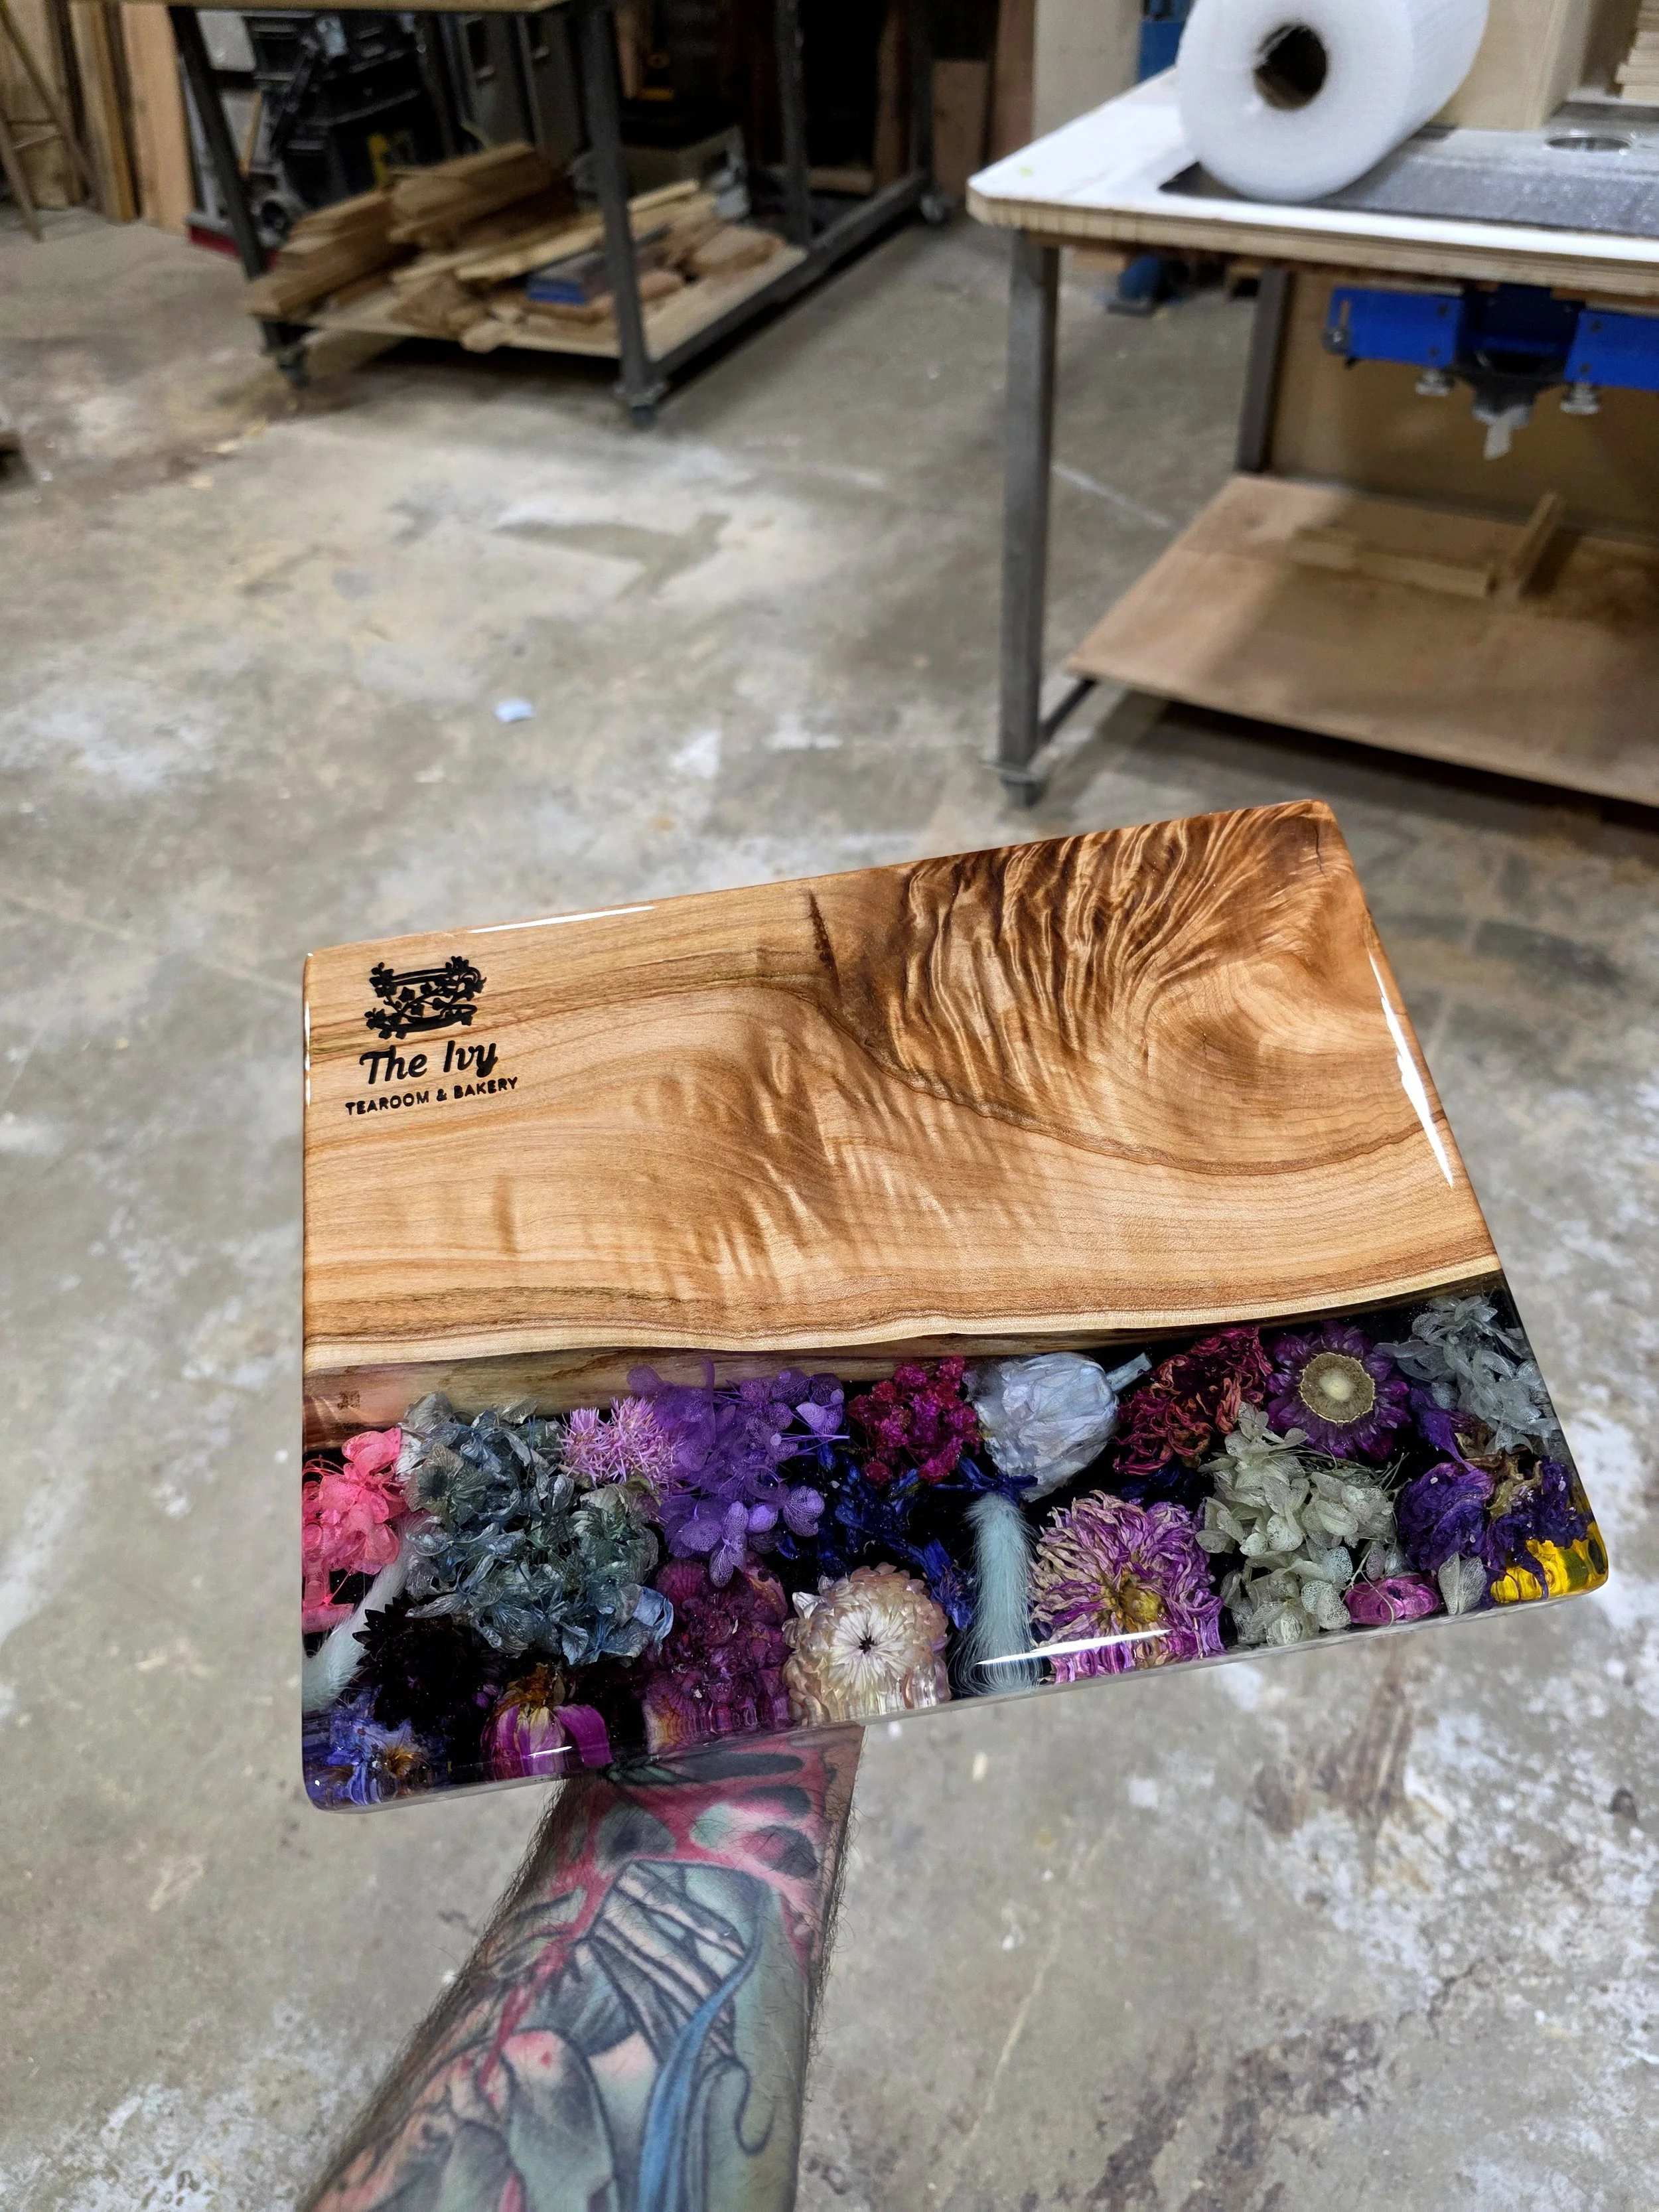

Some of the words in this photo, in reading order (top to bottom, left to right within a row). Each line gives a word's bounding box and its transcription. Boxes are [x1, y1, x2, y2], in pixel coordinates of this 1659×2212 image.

[359, 1045, 428, 1084] The
[443, 1040, 498, 1078] Ivy
[345, 1090, 429, 1116] TEAROOM
[436, 1088, 447, 1102] &
[453, 1076, 518, 1100] BAKERY
